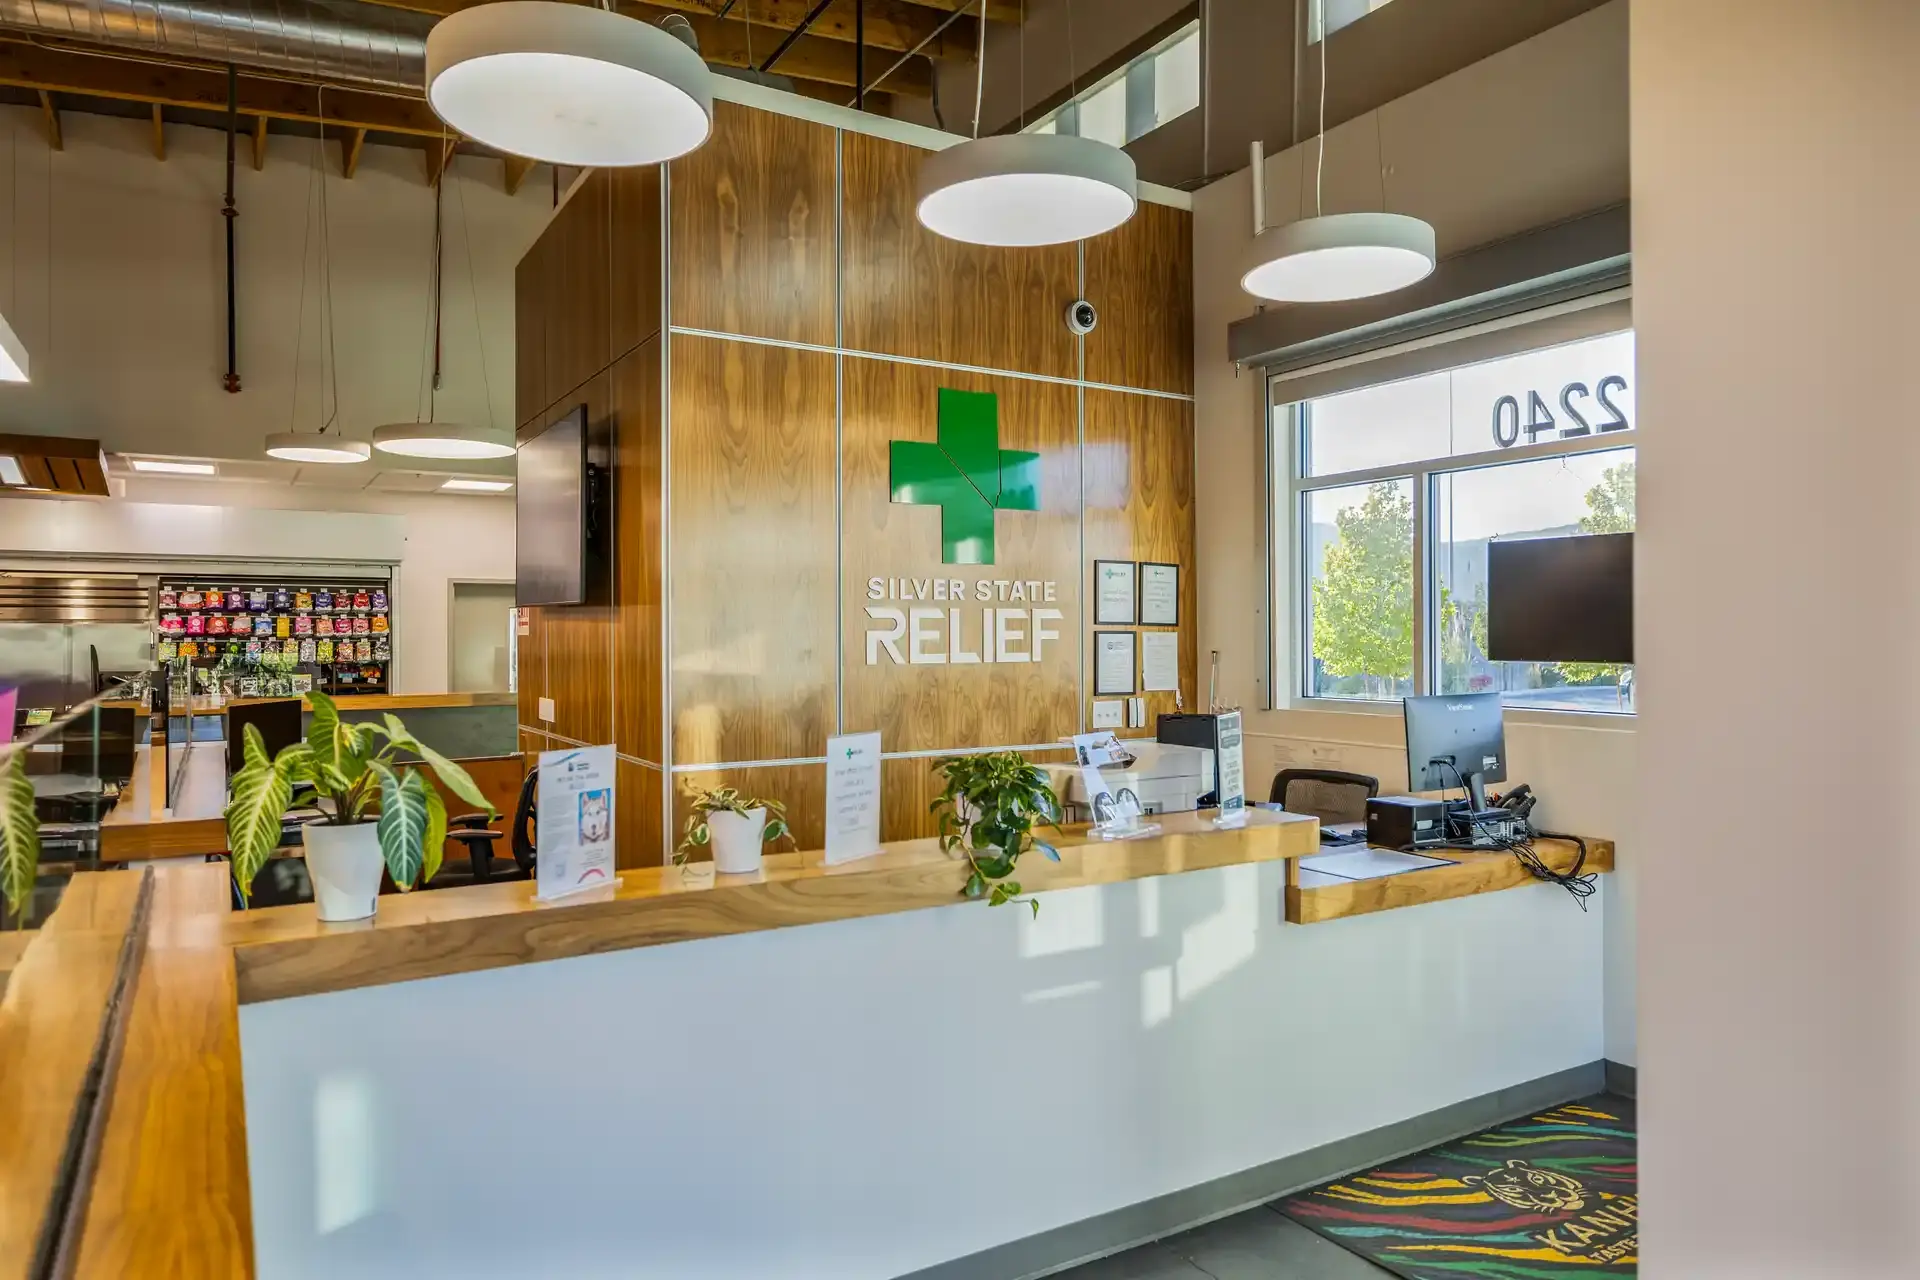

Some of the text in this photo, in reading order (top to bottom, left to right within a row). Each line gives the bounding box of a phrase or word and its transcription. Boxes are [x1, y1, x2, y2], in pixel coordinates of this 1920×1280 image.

[867, 577, 1057, 602] SILVER STATE
[864, 606, 1064, 665] RELIEF
[1535, 1194, 1638, 1253] KANH
